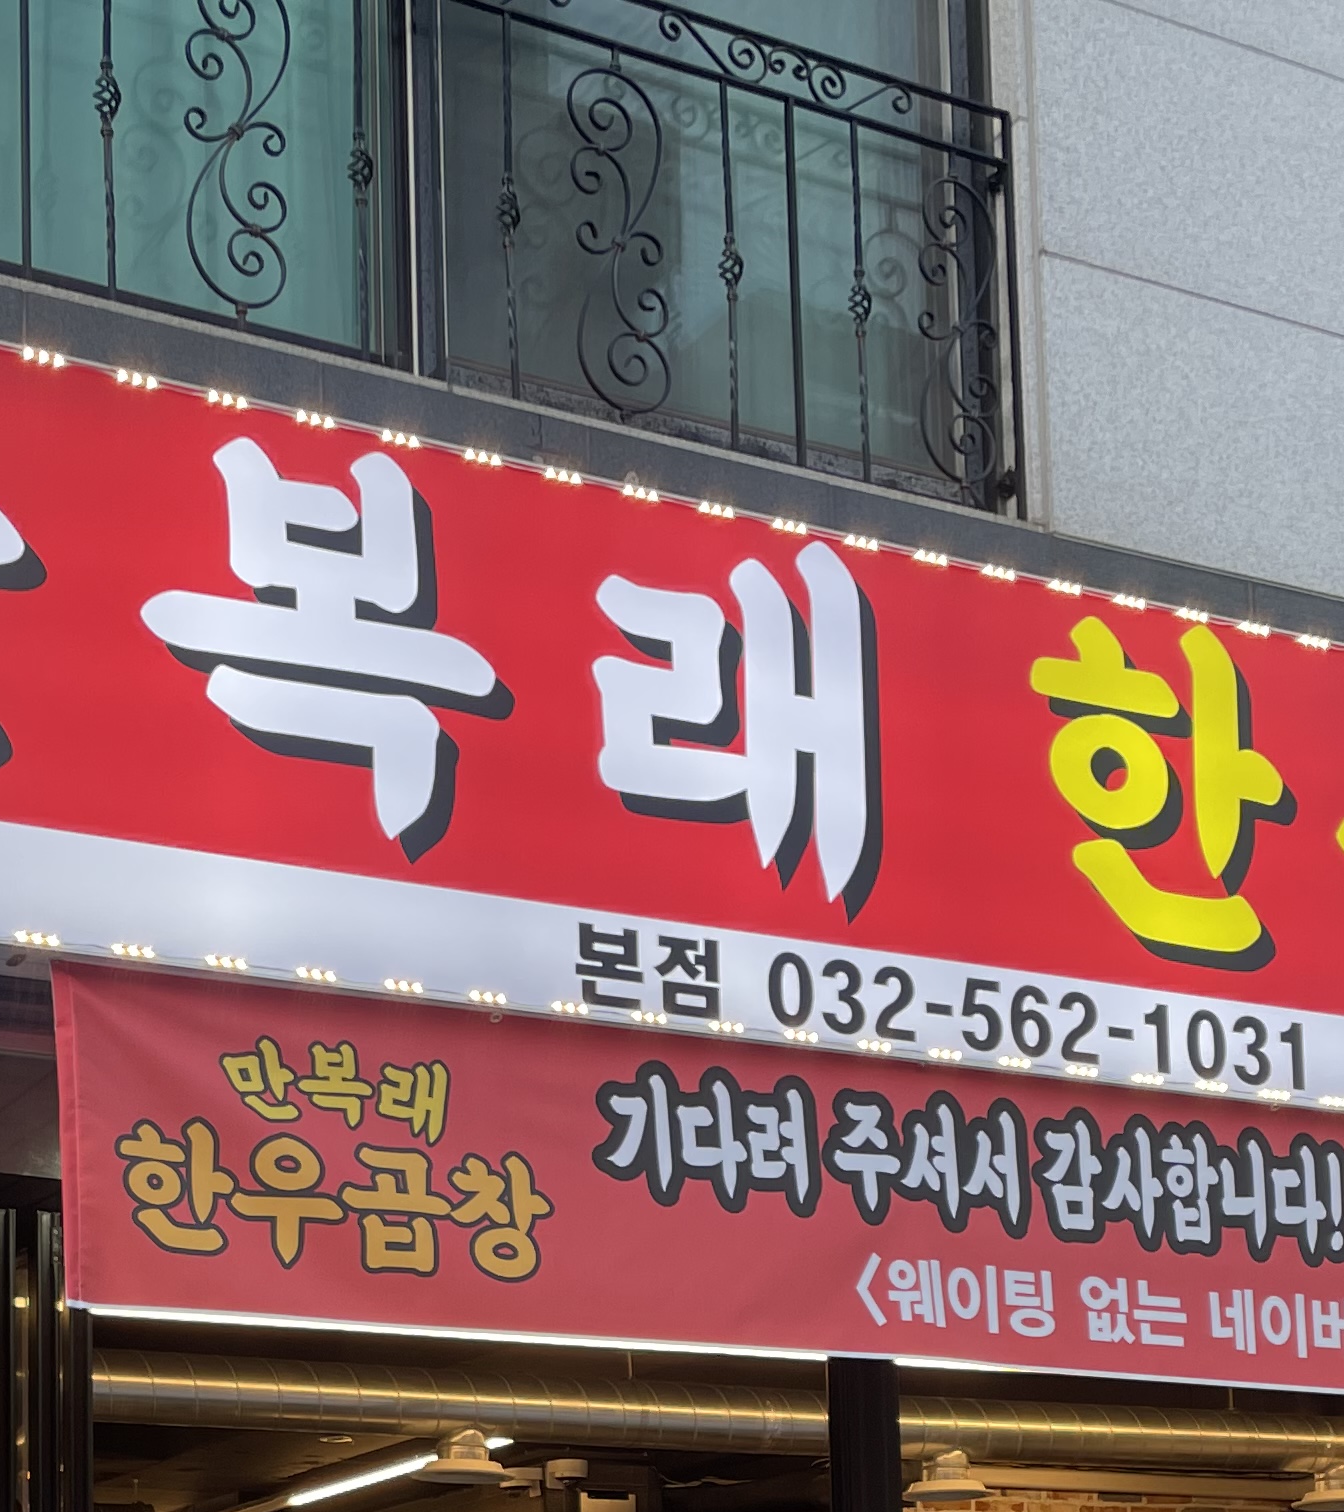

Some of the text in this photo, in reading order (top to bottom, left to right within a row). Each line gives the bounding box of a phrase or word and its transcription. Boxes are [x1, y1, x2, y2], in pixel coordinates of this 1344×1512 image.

[575, 922, 1308, 1090] 본점 032-562-1031
[221, 1037, 449, 1144] 만복래
[602, 1070, 814, 1210] 기다려
[832, 1097, 1022, 1228] 주셔서
[117, 1119, 554, 1281] 한우곱창
[1080, 1277, 1187, 1347] 없는
